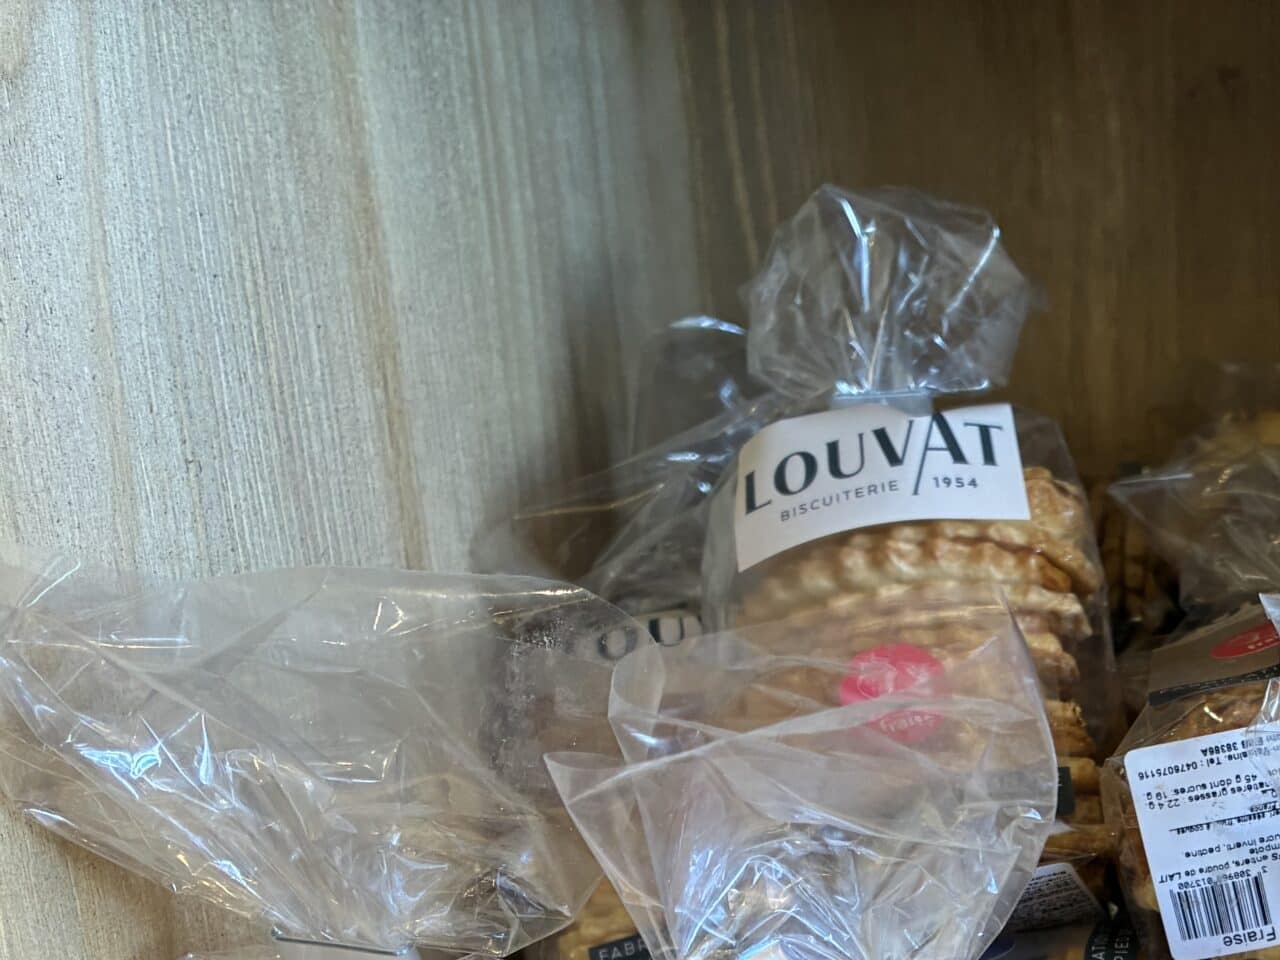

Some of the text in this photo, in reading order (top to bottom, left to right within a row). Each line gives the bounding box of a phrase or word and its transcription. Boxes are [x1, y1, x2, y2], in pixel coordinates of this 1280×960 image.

[744, 411, 1003, 514] LOUVAT
[781, 476, 978, 521] BISCUITERIE 1954
[1209, 778, 1232, 789] dont
[1222, 926, 1275, 949] Fraise
